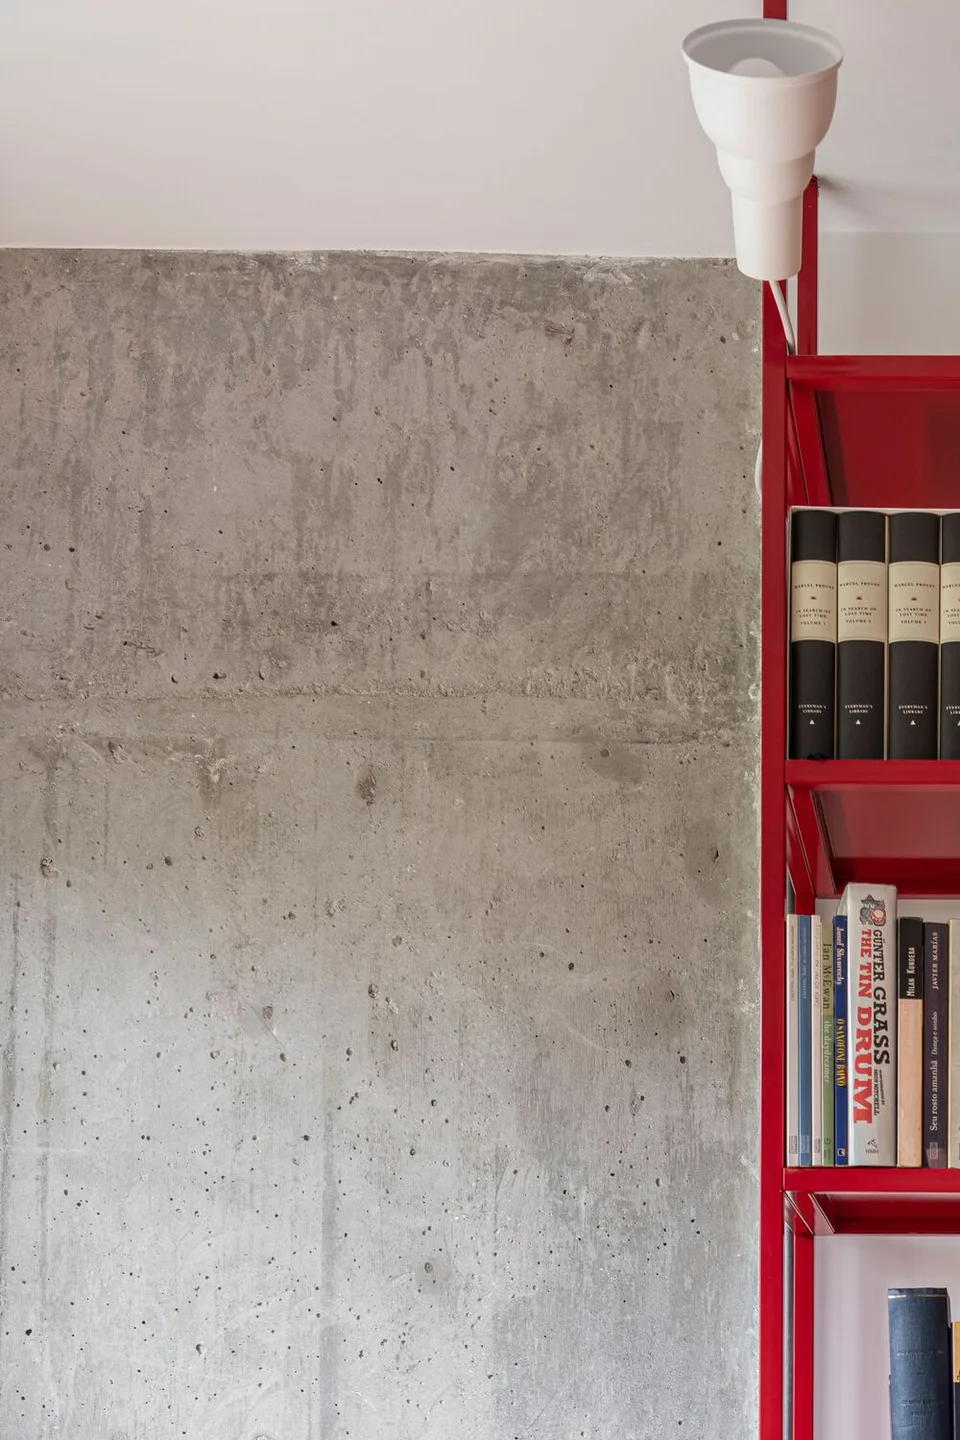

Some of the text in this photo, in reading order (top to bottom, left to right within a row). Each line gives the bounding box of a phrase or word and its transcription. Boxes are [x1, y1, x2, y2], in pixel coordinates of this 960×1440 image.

[823, 943, 832, 961] Ian
[873, 929, 890, 1065] GÜNTER GRASS
[824, 1020, 832, 1033] the
[853, 929, 872, 1123] THE TIN DRUM
[823, 1035, 832, 1083] daydreamer
